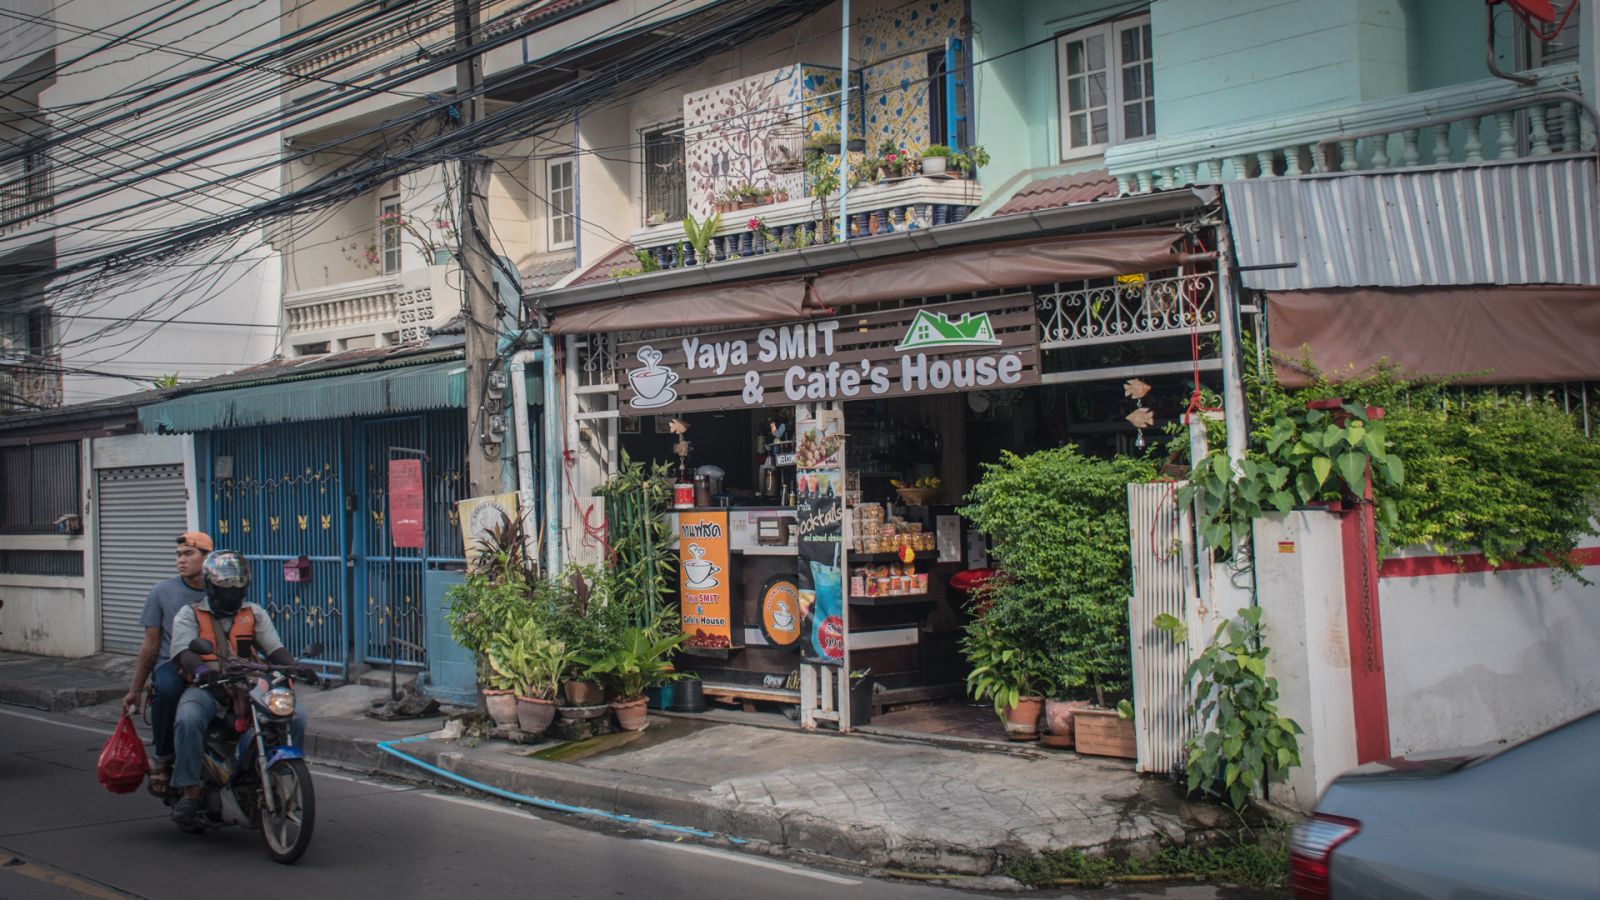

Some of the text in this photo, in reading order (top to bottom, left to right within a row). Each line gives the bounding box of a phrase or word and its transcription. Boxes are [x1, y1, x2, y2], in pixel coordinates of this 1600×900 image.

[682, 322, 839, 375] Yaya SMIT
[742, 352, 1023, 404] & Cafe's House
[800, 502, 842, 535] ocktails
[700, 616, 725, 625] House
